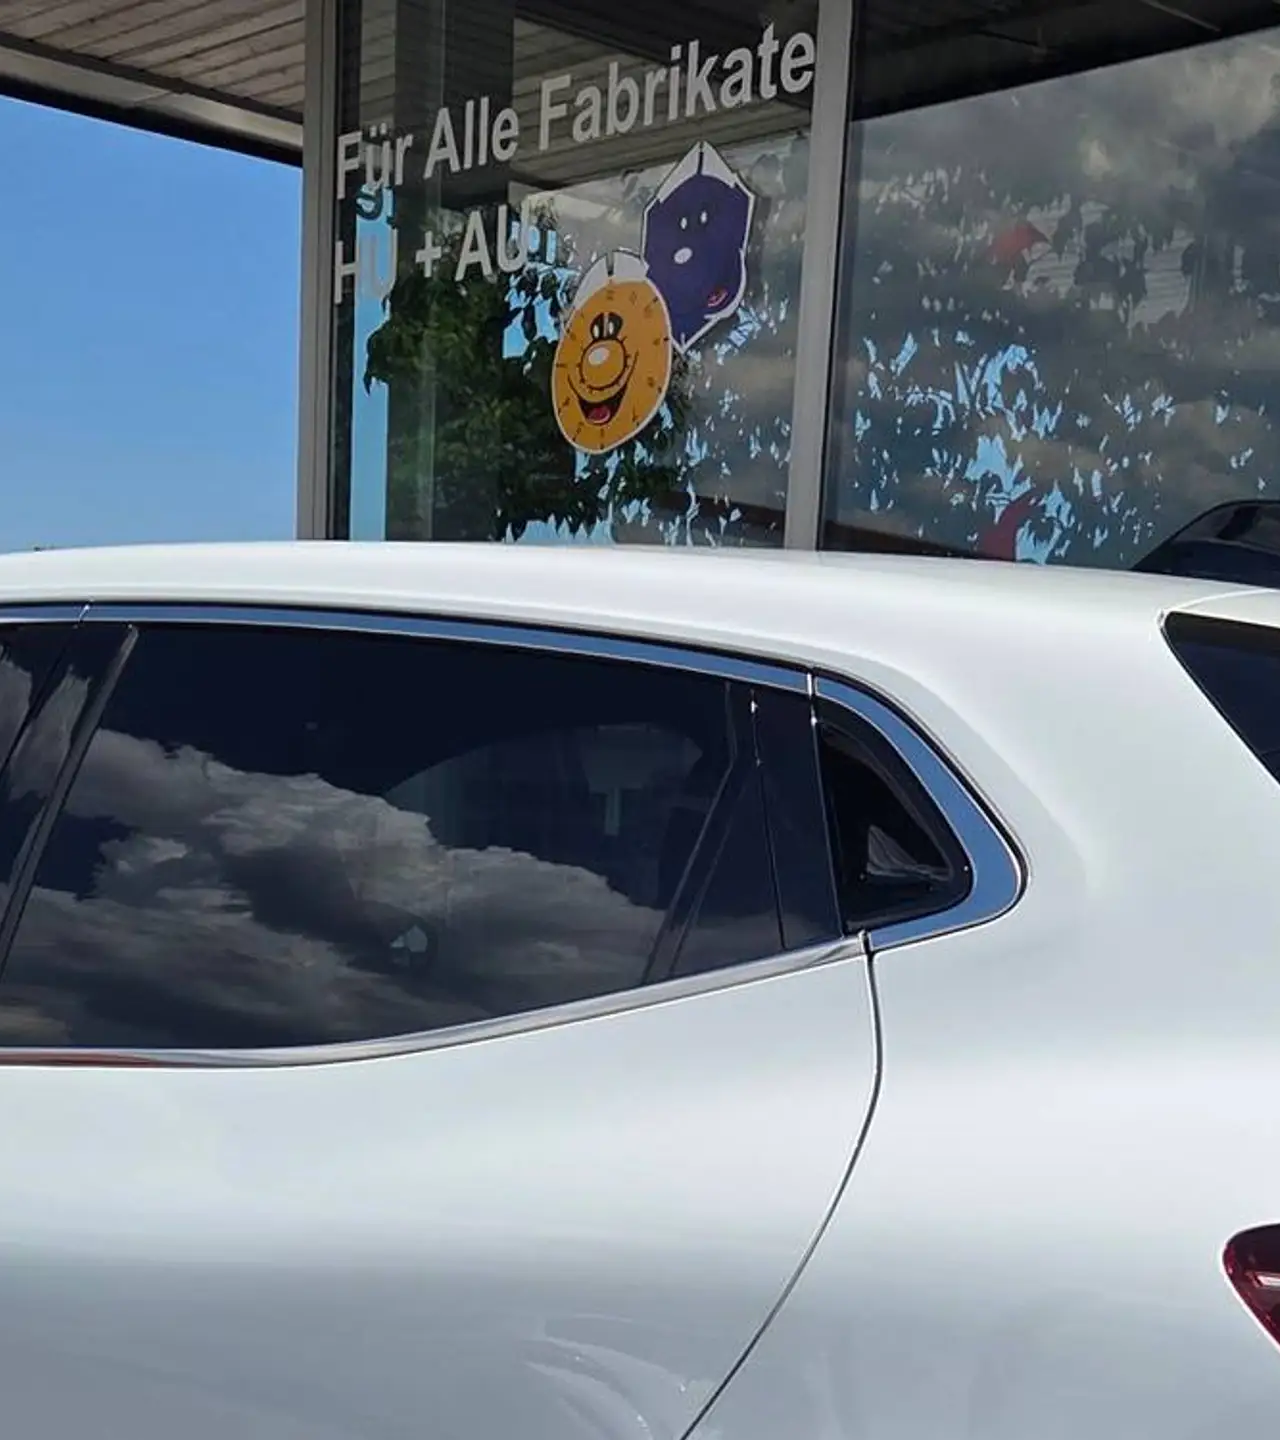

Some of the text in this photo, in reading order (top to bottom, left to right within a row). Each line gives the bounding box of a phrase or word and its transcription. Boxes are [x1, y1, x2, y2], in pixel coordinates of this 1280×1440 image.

[336, 22, 815, 200] Für Alle Fabrikate
